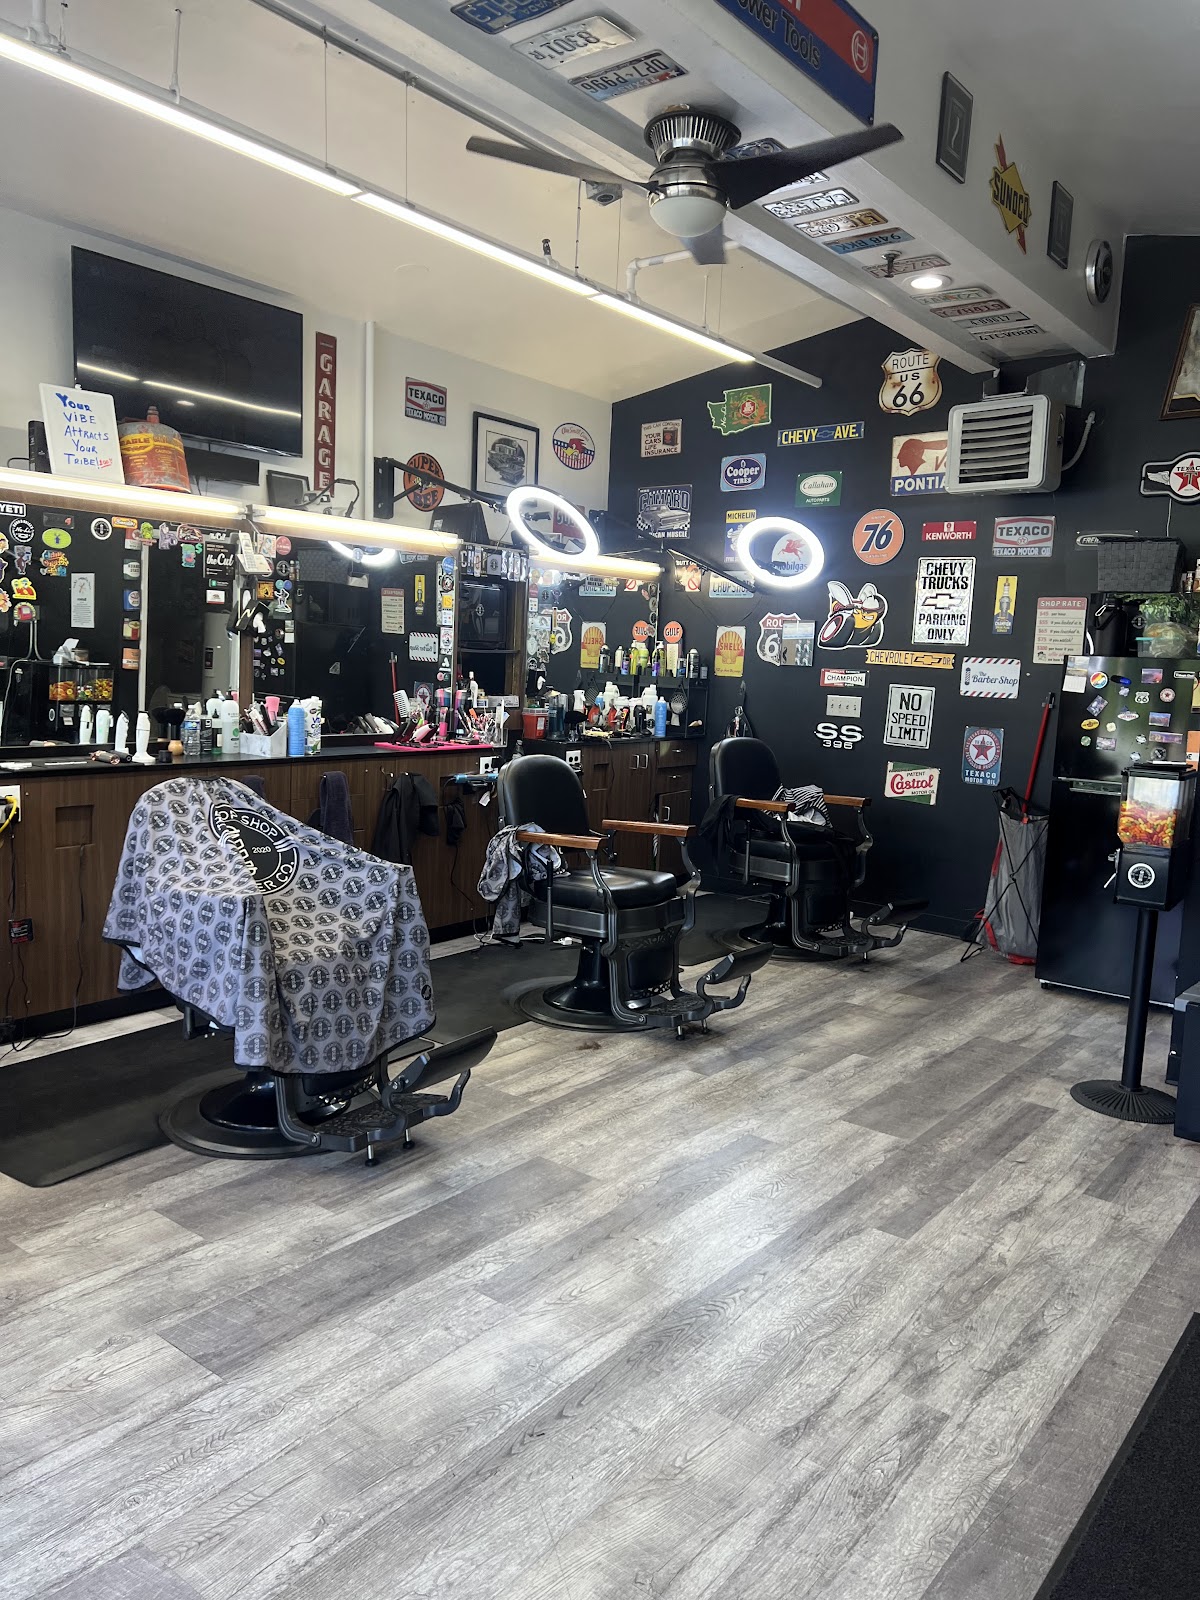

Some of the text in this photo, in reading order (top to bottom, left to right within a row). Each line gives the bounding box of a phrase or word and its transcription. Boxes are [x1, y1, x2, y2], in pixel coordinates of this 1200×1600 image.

[781, 9, 822, 70] Tools
[580, 71, 628, 94] P996
[992, 172, 1029, 224] SUNOCO
[892, 354, 930, 370] ROUTE
[900, 373, 921, 383] US
[408, 387, 445, 405] TEXACO
[892, 383, 925, 408] 66
[317, 353, 334, 490] GARAGE
[781, 424, 859, 445] CHEVY AVE.
[644, 447, 679, 456] INSURANCE
[409, 456, 442, 477] UPER
[726, 465, 760, 479] Cooper
[733, 477, 752, 485] TIRES
[802, 481, 835, 490] Callahan
[894, 476, 946, 492] PONTIA
[413, 490, 439, 508] BEE
[0, 503, 23, 515] YETI
[727, 512, 756, 520] MICHELIN
[667, 530, 688, 538] MUSCLE
[860, 519, 895, 554] 76
[925, 531, 972, 541] KENWORTH
[998, 525, 1050, 537] TEXACO
[993, 547, 1016, 556] TEXACO
[1017, 547, 1039, 556] MOTOR
[926, 562, 967, 576] CHEVY
[921, 576, 969, 590] TRUCKS
[766, 618, 783, 628] ROU
[918, 613, 967, 626] PARKING
[665, 627, 681, 637] GULF
[927, 628, 955, 641] ONLY
[719, 642, 742, 651] SHELL
[869, 651, 915, 665] CHEVROLET
[826, 674, 863, 683] CHAMPION
[971, 675, 1019, 687] Barber Shop
[899, 692, 923, 712] NO
[891, 712, 927, 727] SPEED
[815, 722, 863, 742] SS
[889, 726, 926, 742] LIMIT
[822, 739, 853, 749] 396
[965, 769, 997, 779] TEXACO
[891, 774, 934, 795] Castrol
[239, 815, 278, 837] SHOP
[251, 846, 271, 854] 2020
